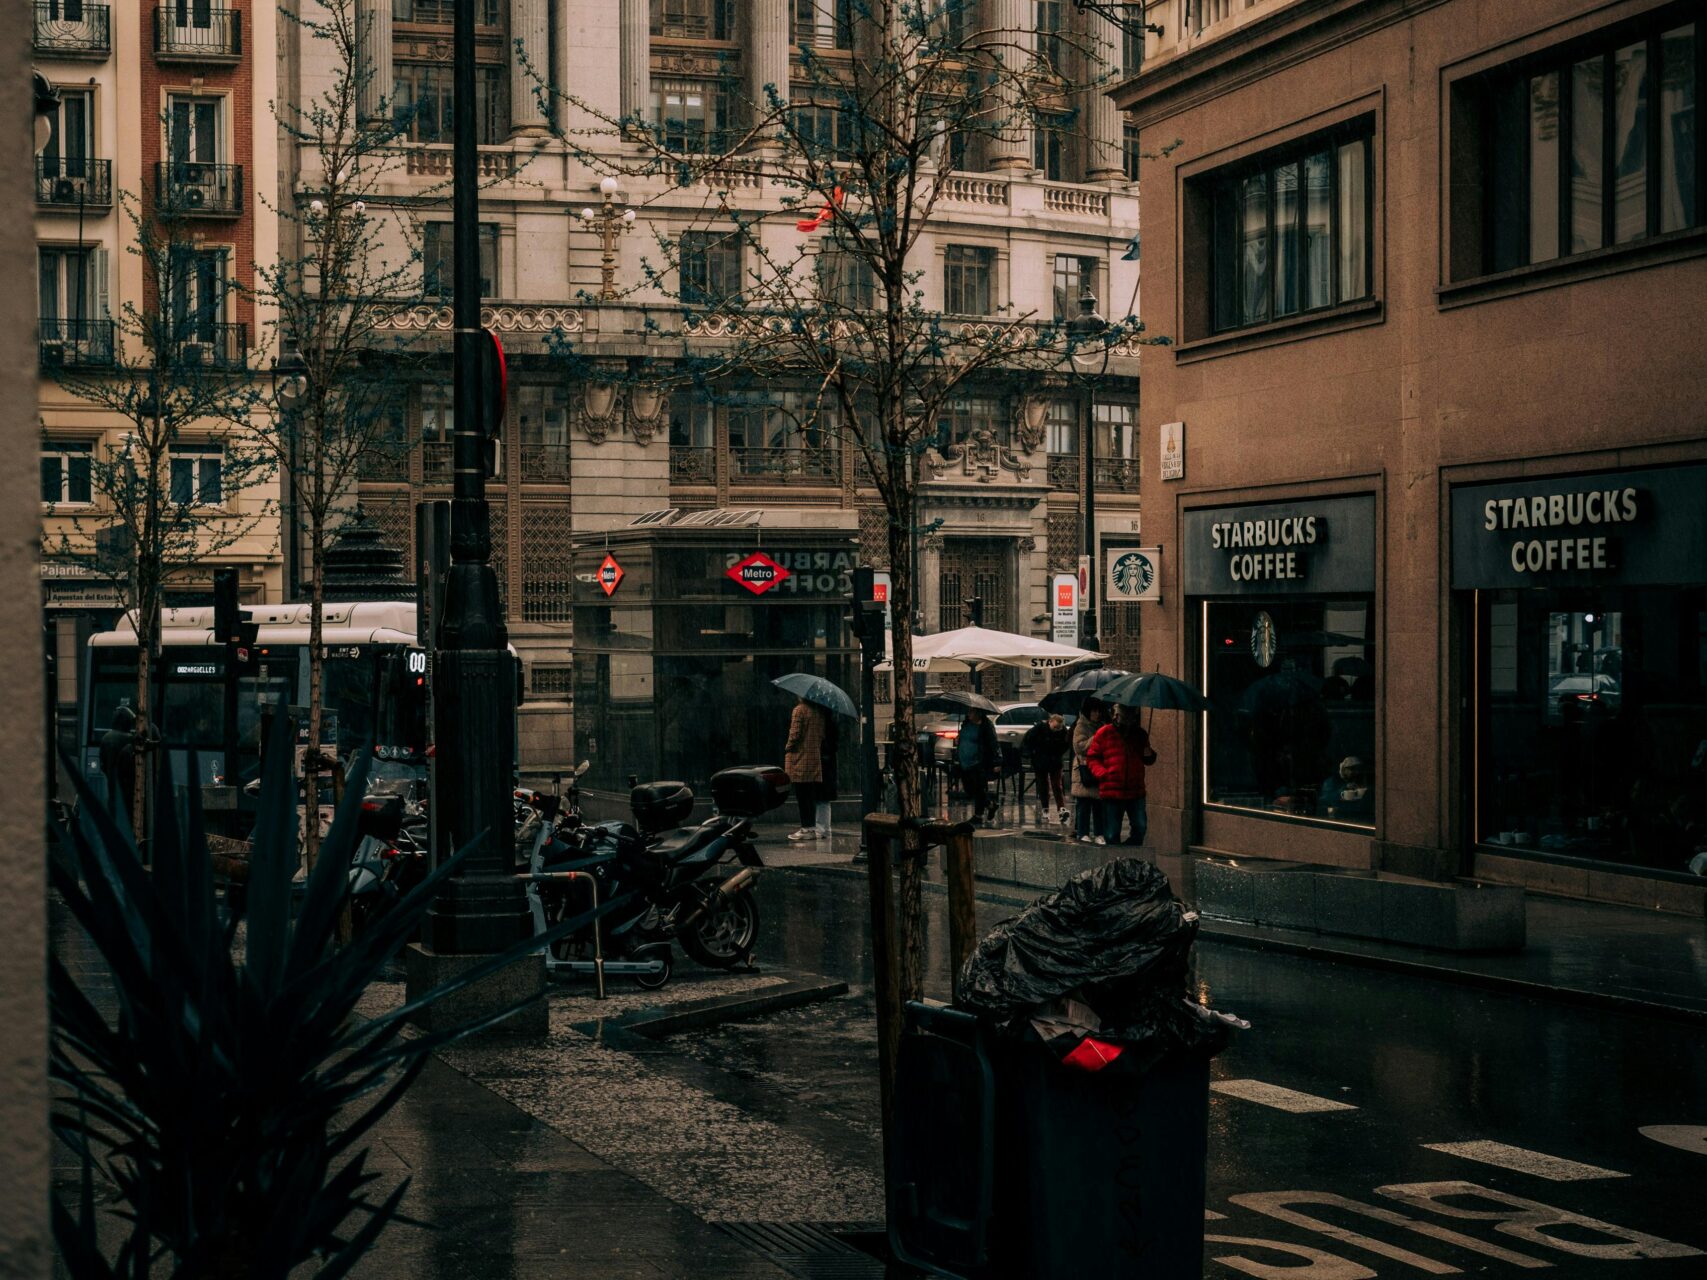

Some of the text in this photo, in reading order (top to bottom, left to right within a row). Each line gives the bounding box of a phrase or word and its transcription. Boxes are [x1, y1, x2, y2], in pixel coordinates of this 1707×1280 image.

[1484, 487, 1638, 531] STARBUCKS
[1211, 516, 1317, 549] STARBUCKS
[1230, 553, 1297, 581] COFFEE
[1511, 536, 1607, 573] COFFEE
[744, 568, 773, 578] Metro
[52, 594, 84, 602] Apuestas
